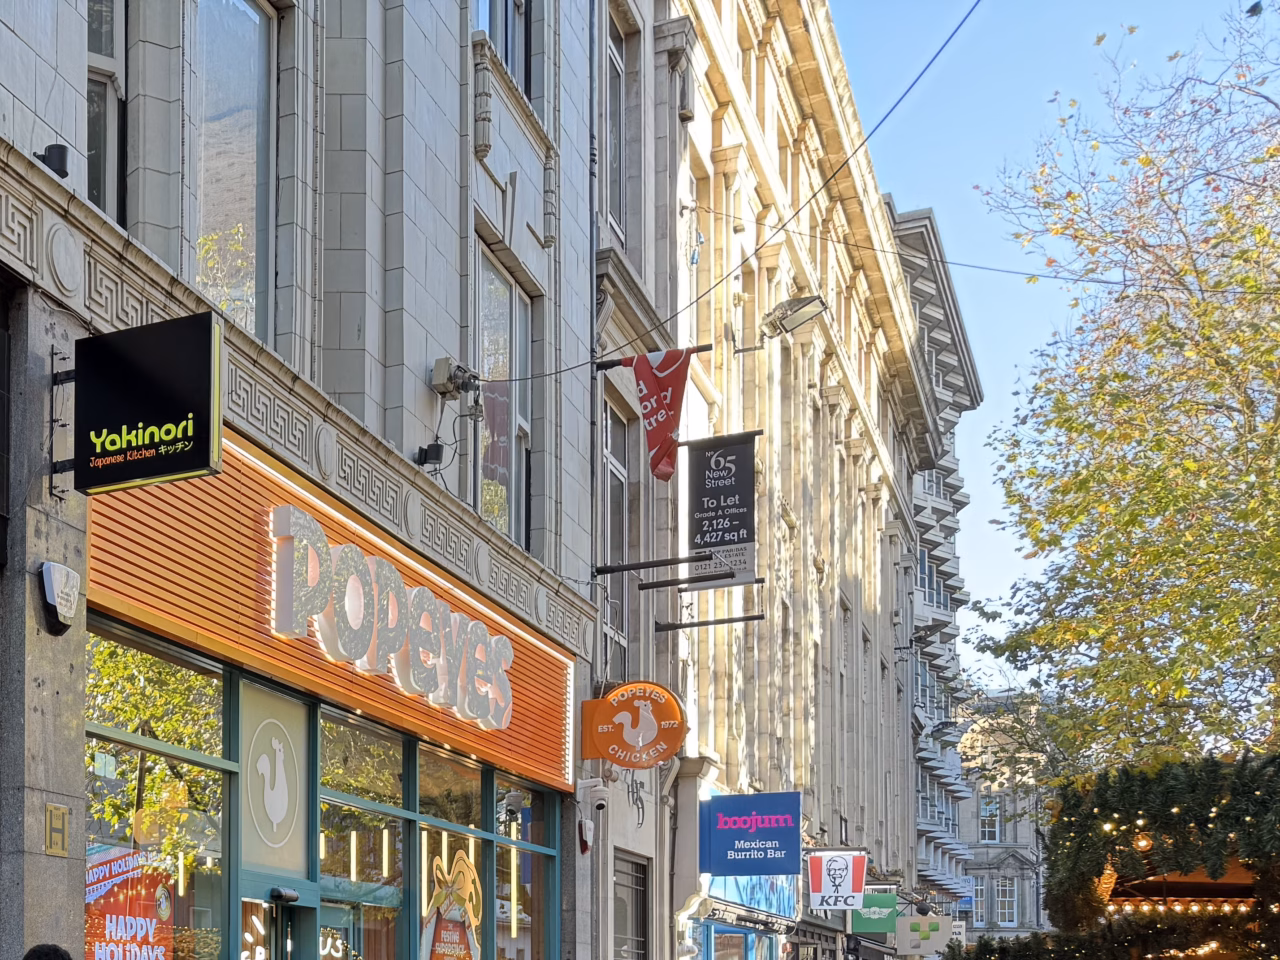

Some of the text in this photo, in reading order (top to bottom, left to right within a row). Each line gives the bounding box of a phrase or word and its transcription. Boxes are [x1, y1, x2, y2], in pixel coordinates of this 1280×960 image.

[90, 412, 193, 453] Yakinori
[90, 447, 156, 468] Japanese Kitchen
[710, 449, 736, 478] 65
[705, 469, 728, 479] New
[705, 477, 735, 488] Street
[702, 494, 739, 508] To Let
[694, 510, 716, 519] Grade
[724, 507, 747, 515] Offices
[702, 518, 730, 531] 2,126
[694, 528, 747, 545] 4,427 sq ft
[610, 686, 668, 706] POPEYES
[598, 720, 679, 733] EST. 1972
[608, 741, 668, 762] CHICKEN
[716, 811, 795, 833] boojum
[734, 840, 779, 849] Mexican
[727, 849, 787, 859] Burrito Bar
[818, 895, 855, 907] KFC
[105, 914, 157, 943] HAPPY
